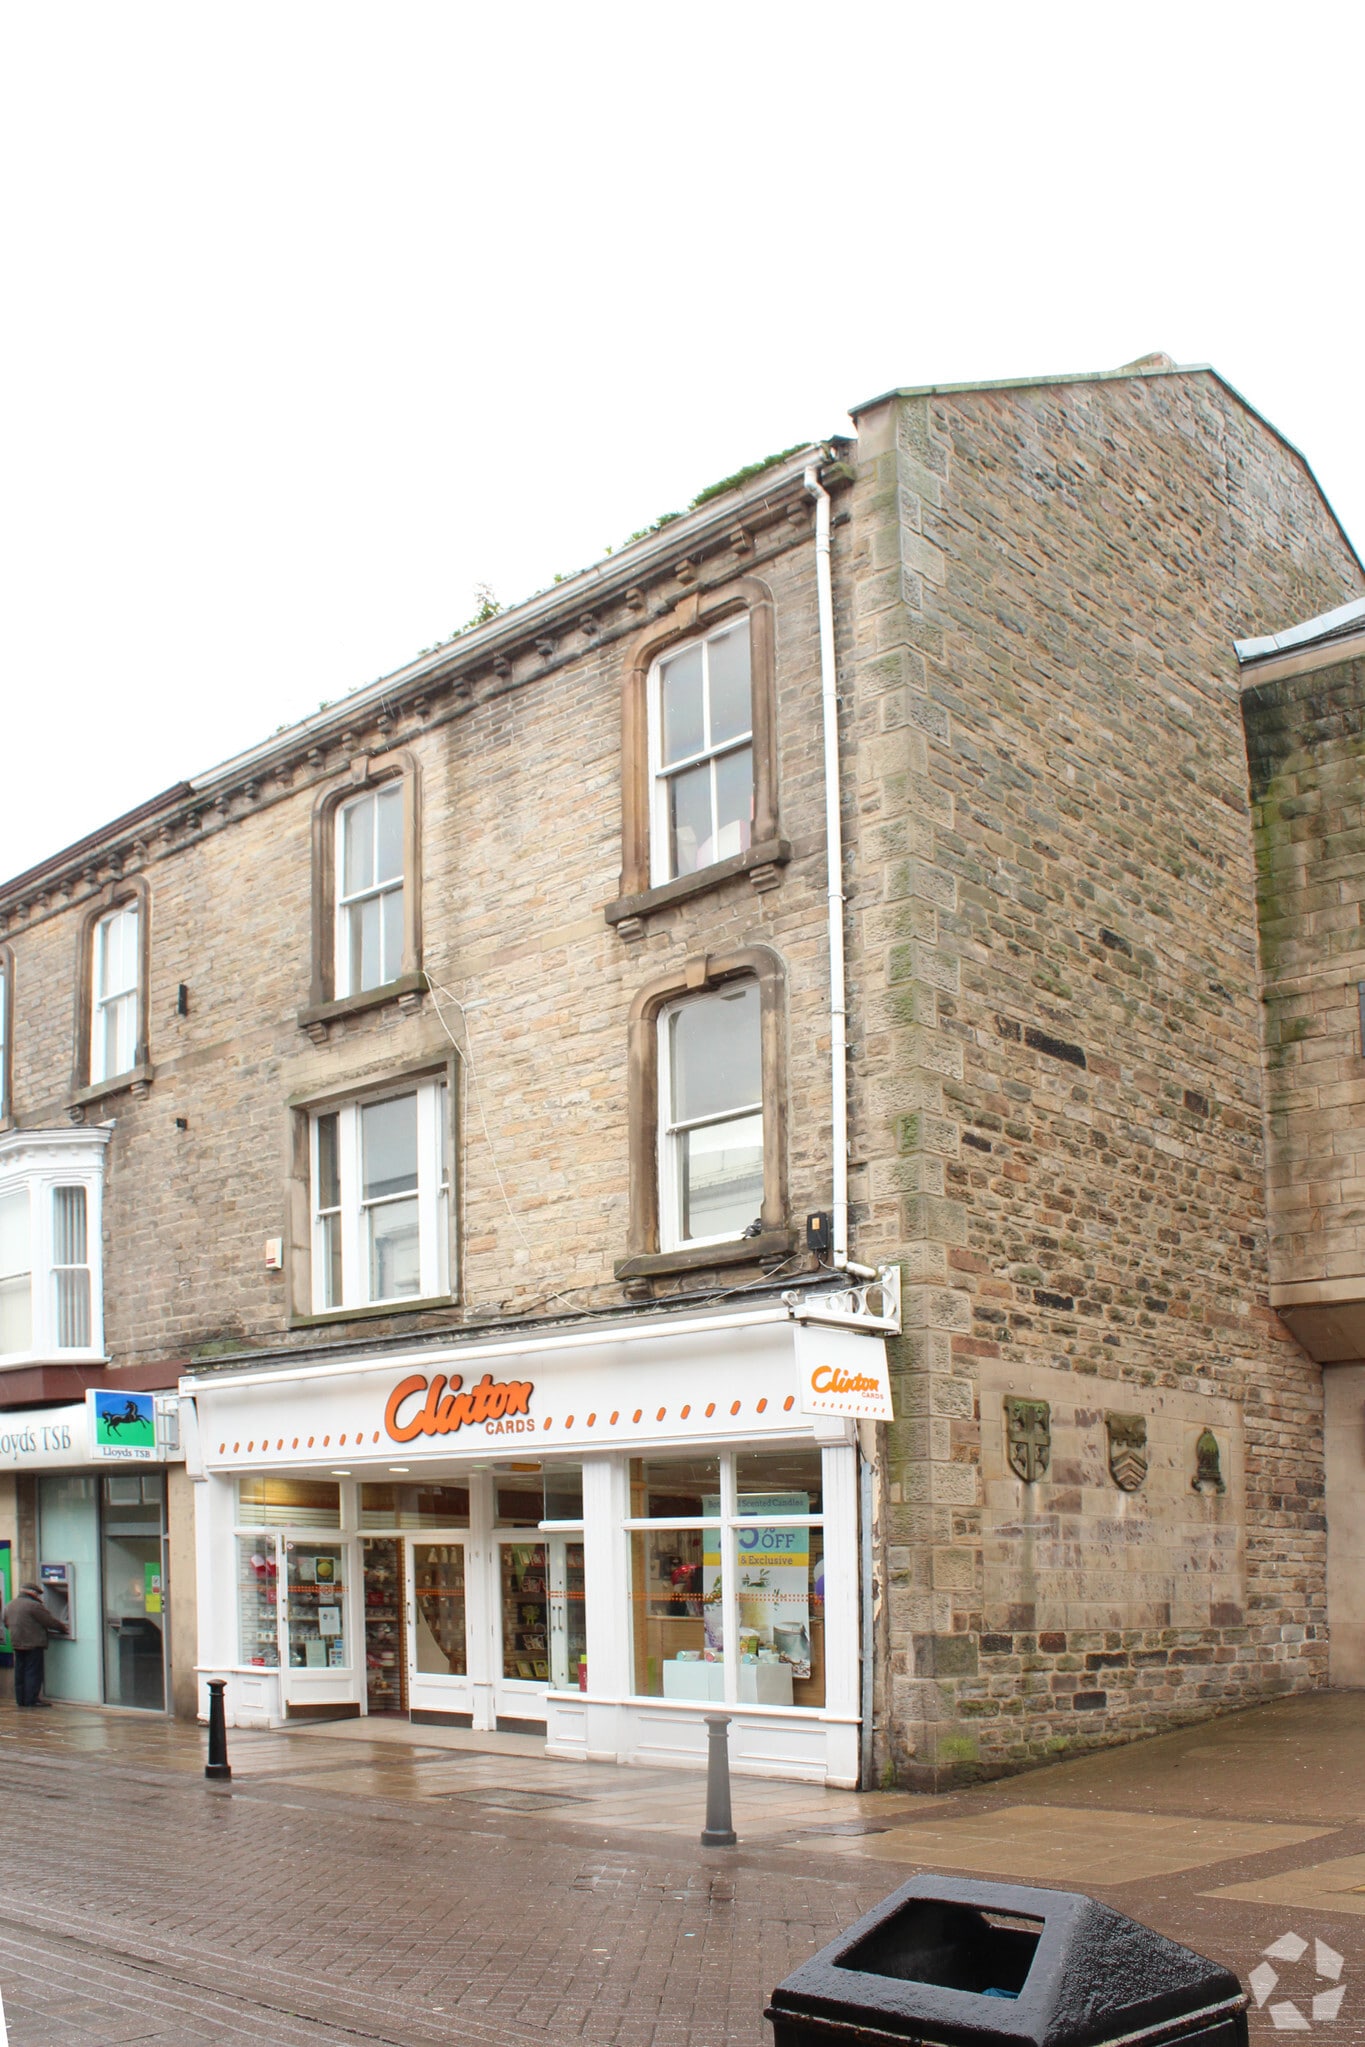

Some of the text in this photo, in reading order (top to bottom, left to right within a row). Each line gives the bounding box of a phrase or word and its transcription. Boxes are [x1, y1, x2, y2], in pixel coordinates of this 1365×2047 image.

[811, 1365, 879, 1393] Clinton
[861, 1391, 884, 1400] CARDS
[384, 1374, 535, 1443] Clinton
[485, 1418, 535, 1435] CARDS
[0, 1425, 71, 1460] oyds TSB
[103, 1446, 151, 1458] Lloyds TSB
[742, 1498, 771, 1507] Scented
[772, 1498, 804, 1507] Candles
[761, 1533, 795, 1548] OFF
[748, 1554, 793, 1565] Exclusive
